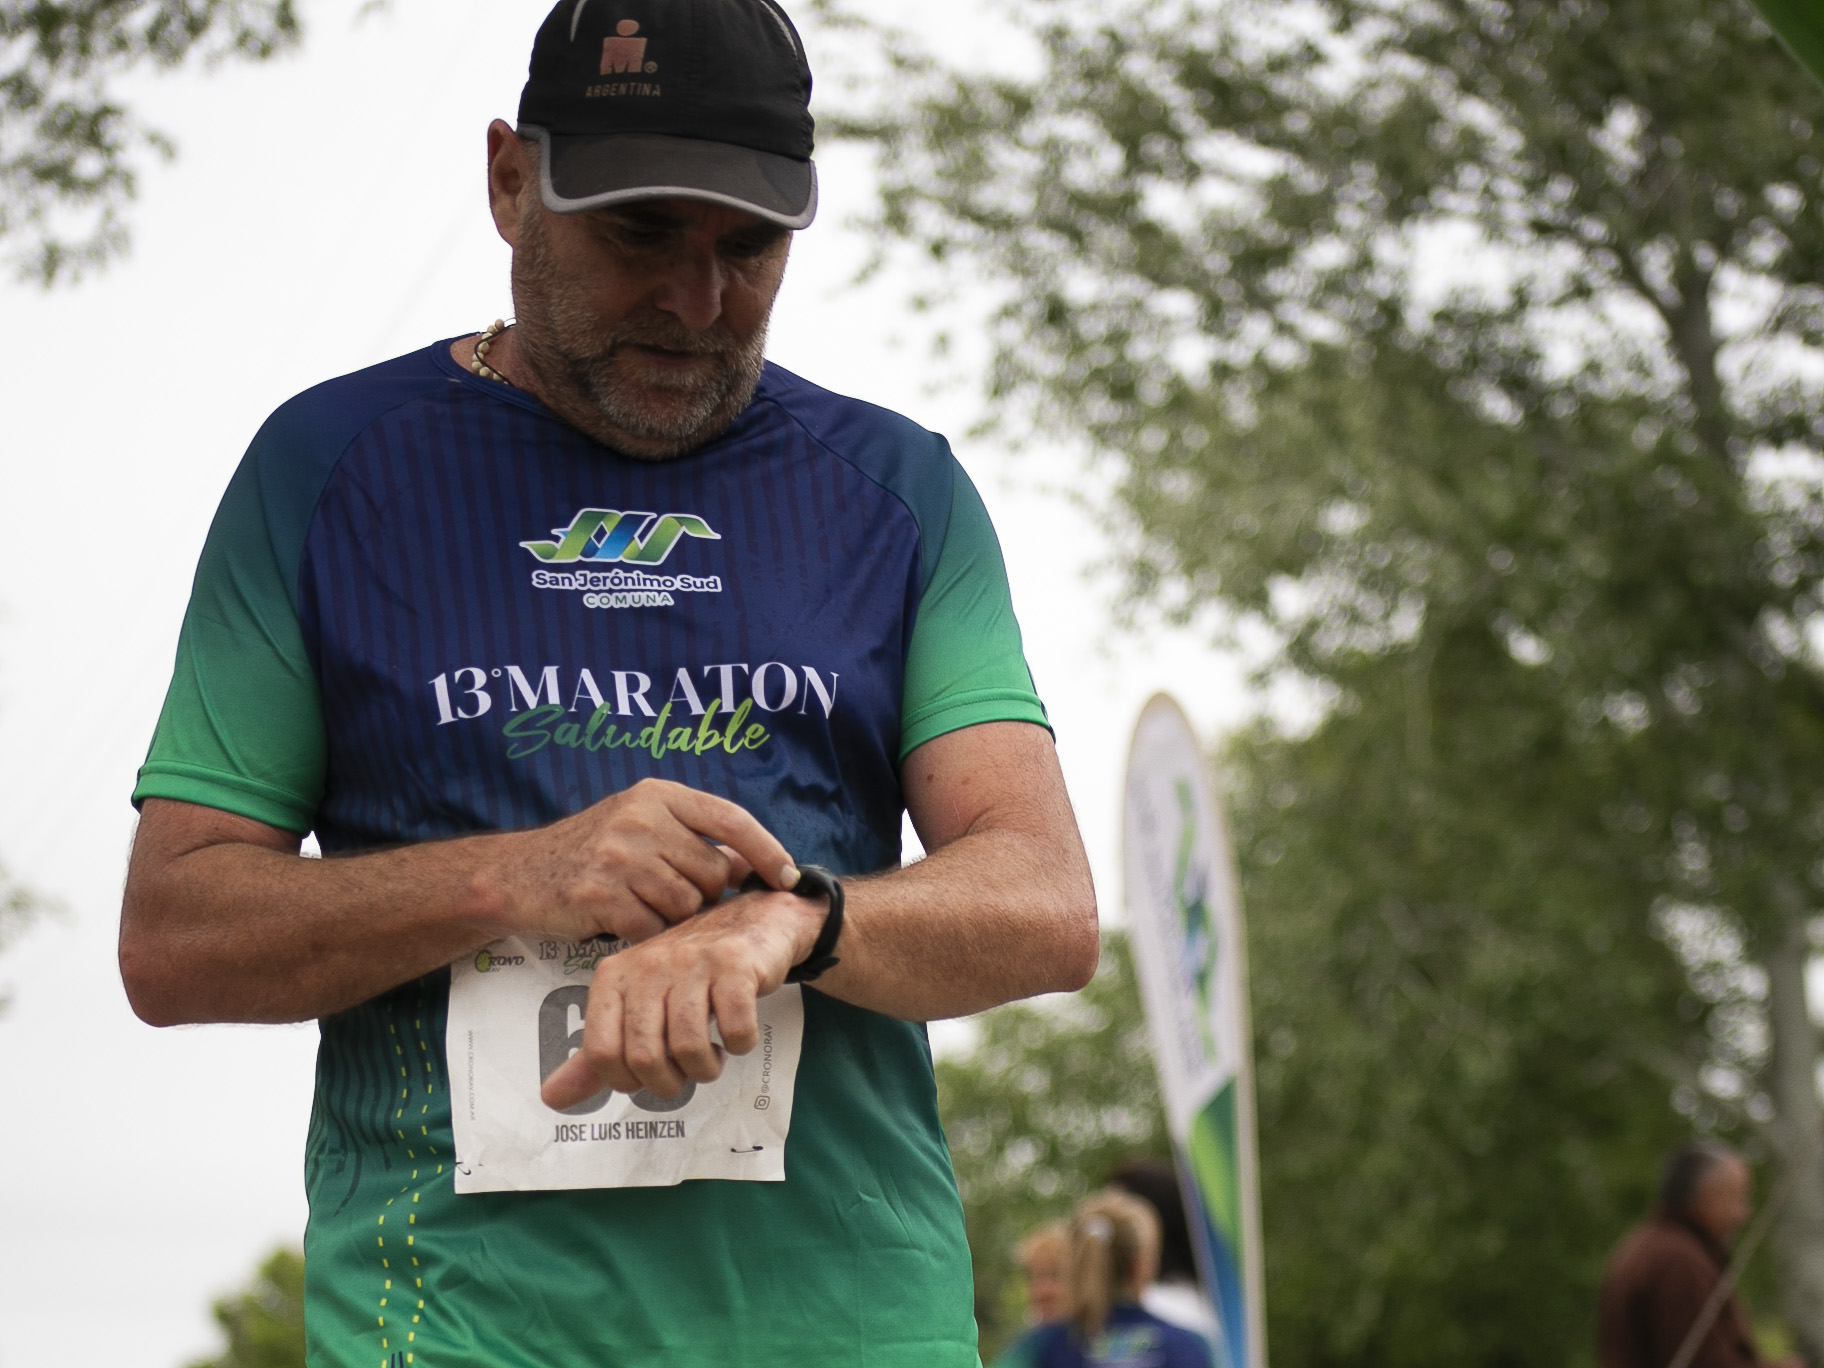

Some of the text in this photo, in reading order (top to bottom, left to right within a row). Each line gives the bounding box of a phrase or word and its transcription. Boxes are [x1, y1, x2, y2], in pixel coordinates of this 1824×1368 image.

[585, 82, 662, 98] ARGENTINA
[533, 568, 720, 591] San Jerónimo Sud
[584, 592, 673, 608] COMUNA
[504, 661, 840, 719] MARATON
[503, 697, 771, 760] Saludable
[761, 1023, 773, 1094] @CRONORAV
[554, 1120, 686, 1143] JOSE LUIS HEINZEN
